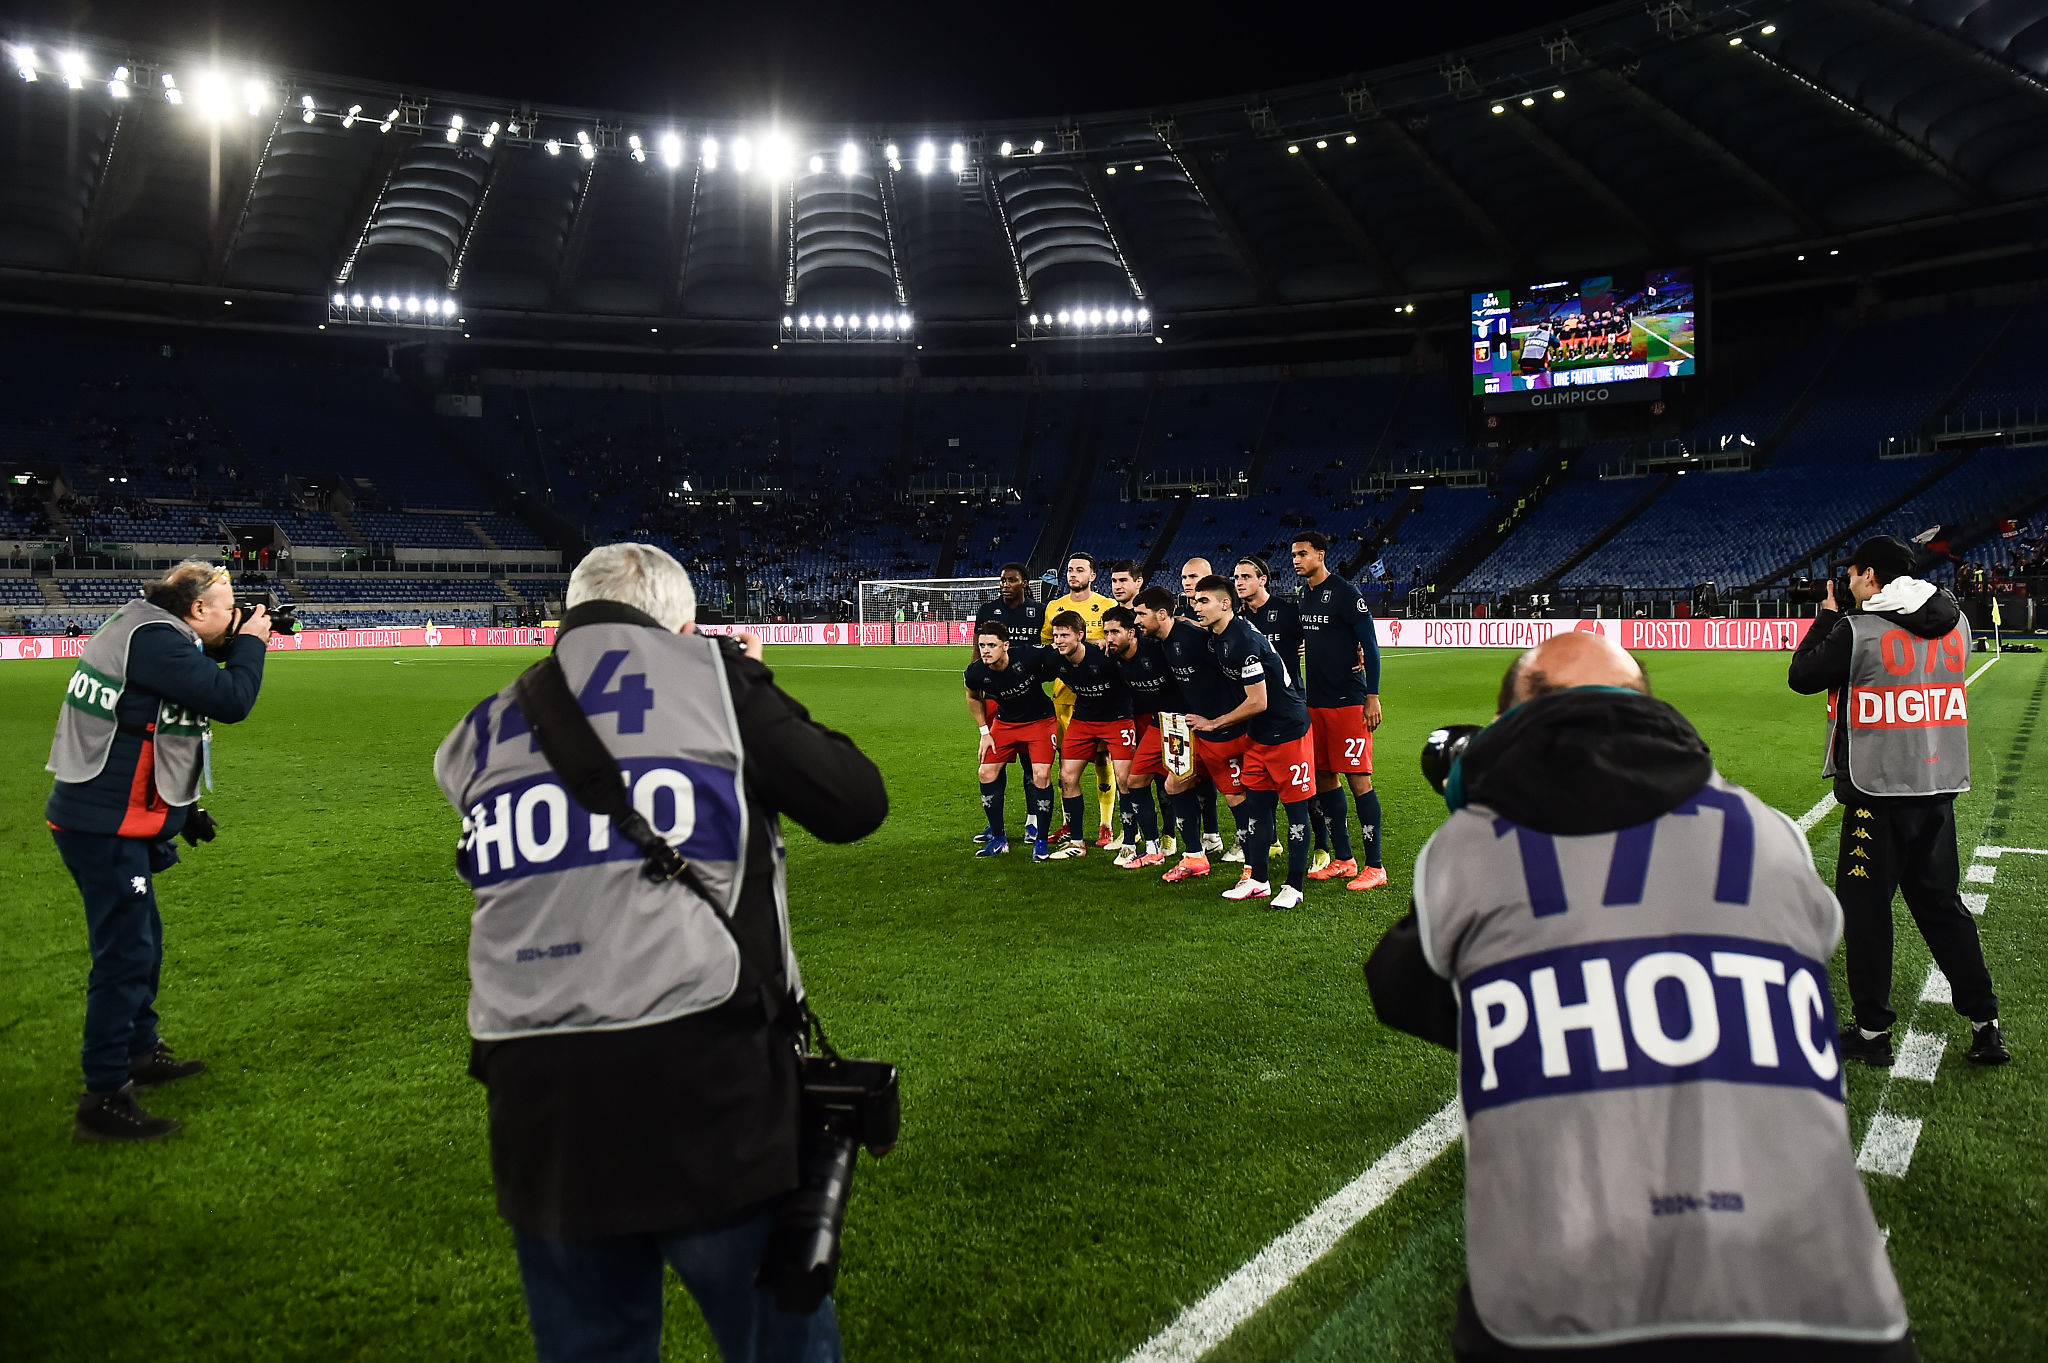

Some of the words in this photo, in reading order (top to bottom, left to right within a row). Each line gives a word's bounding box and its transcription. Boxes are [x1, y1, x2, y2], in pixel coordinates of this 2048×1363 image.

[1499, 318, 1506, 335] 0
[1500, 342, 1507, 359] 0
[1553, 372, 1569, 386] ONE
[1571, 370, 1595, 384] FAITH,
[1597, 368, 1613, 381] ONE
[1614, 364, 1648, 381] PASSION
[1531, 388, 1609, 406] OLIMPICO
[1302, 614, 1329, 624] PULSEE
[319, 632, 349, 648] POSTO
[355, 630, 401, 648] OCCUPATO
[487, 629, 509, 646] POSTO
[513, 628, 546, 646] OCCUPATO
[774, 625, 813, 643] OCCUPATO
[854, 624, 885, 644] POSTO
[1008, 626, 1039, 635] ULSEE
[1425, 622, 1471, 645] POSTO
[1479, 622, 1553, 645] OCCUPATO
[1633, 621, 1691, 649] POSTO
[1704, 620, 1798, 649] OCCUPATO
[1000, 674, 1036, 697] PULSEE
[1074, 682, 1110, 692] PULSEE
[1130, 676, 1166, 688] PULSEE
[1120, 729, 1136, 746] 32
[1344, 738, 1366, 758] 27
[1229, 759, 1241, 778] 3
[1289, 762, 1311, 786] 22
